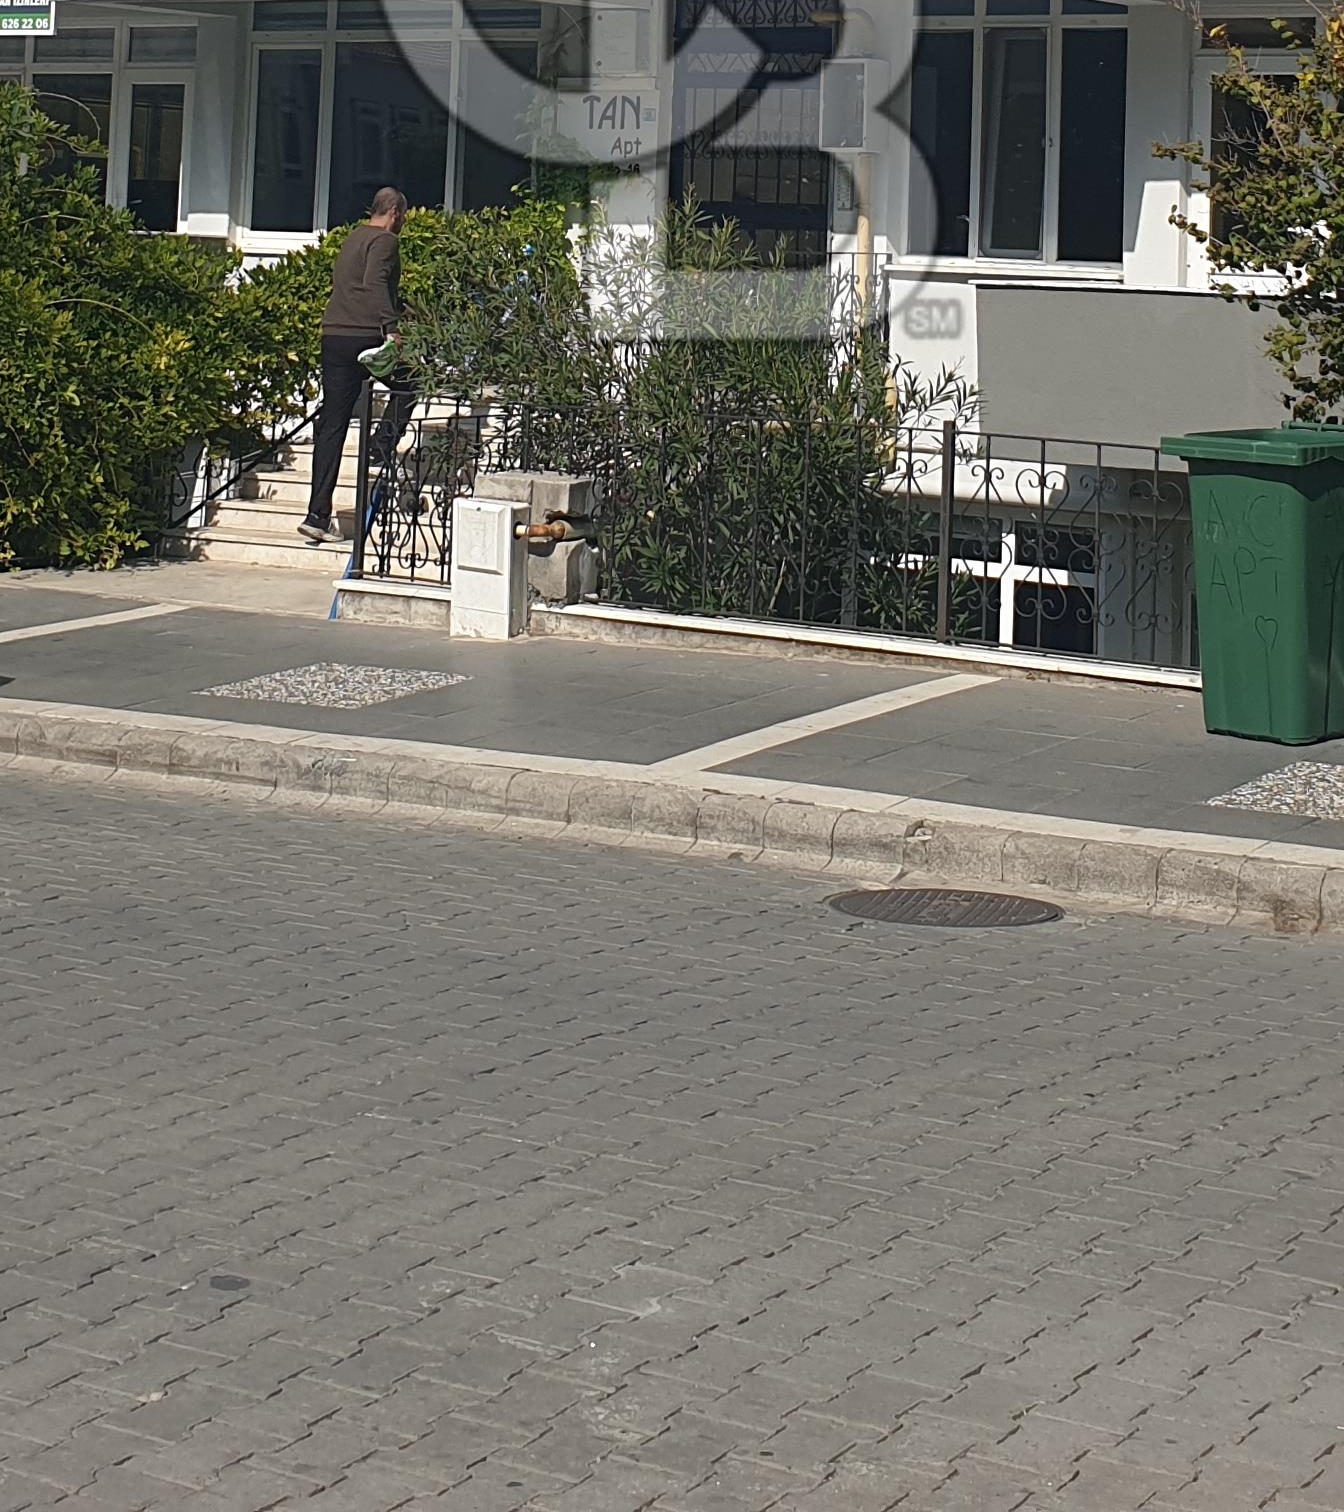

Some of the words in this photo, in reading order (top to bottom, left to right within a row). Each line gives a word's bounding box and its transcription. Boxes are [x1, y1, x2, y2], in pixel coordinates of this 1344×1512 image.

[1, 16, 20, 30] 626
[21, 16, 36, 29] 22
[37, 16, 49, 29] 06
[582, 95, 641, 129] TAN
[610, 136, 642, 158] Apt
